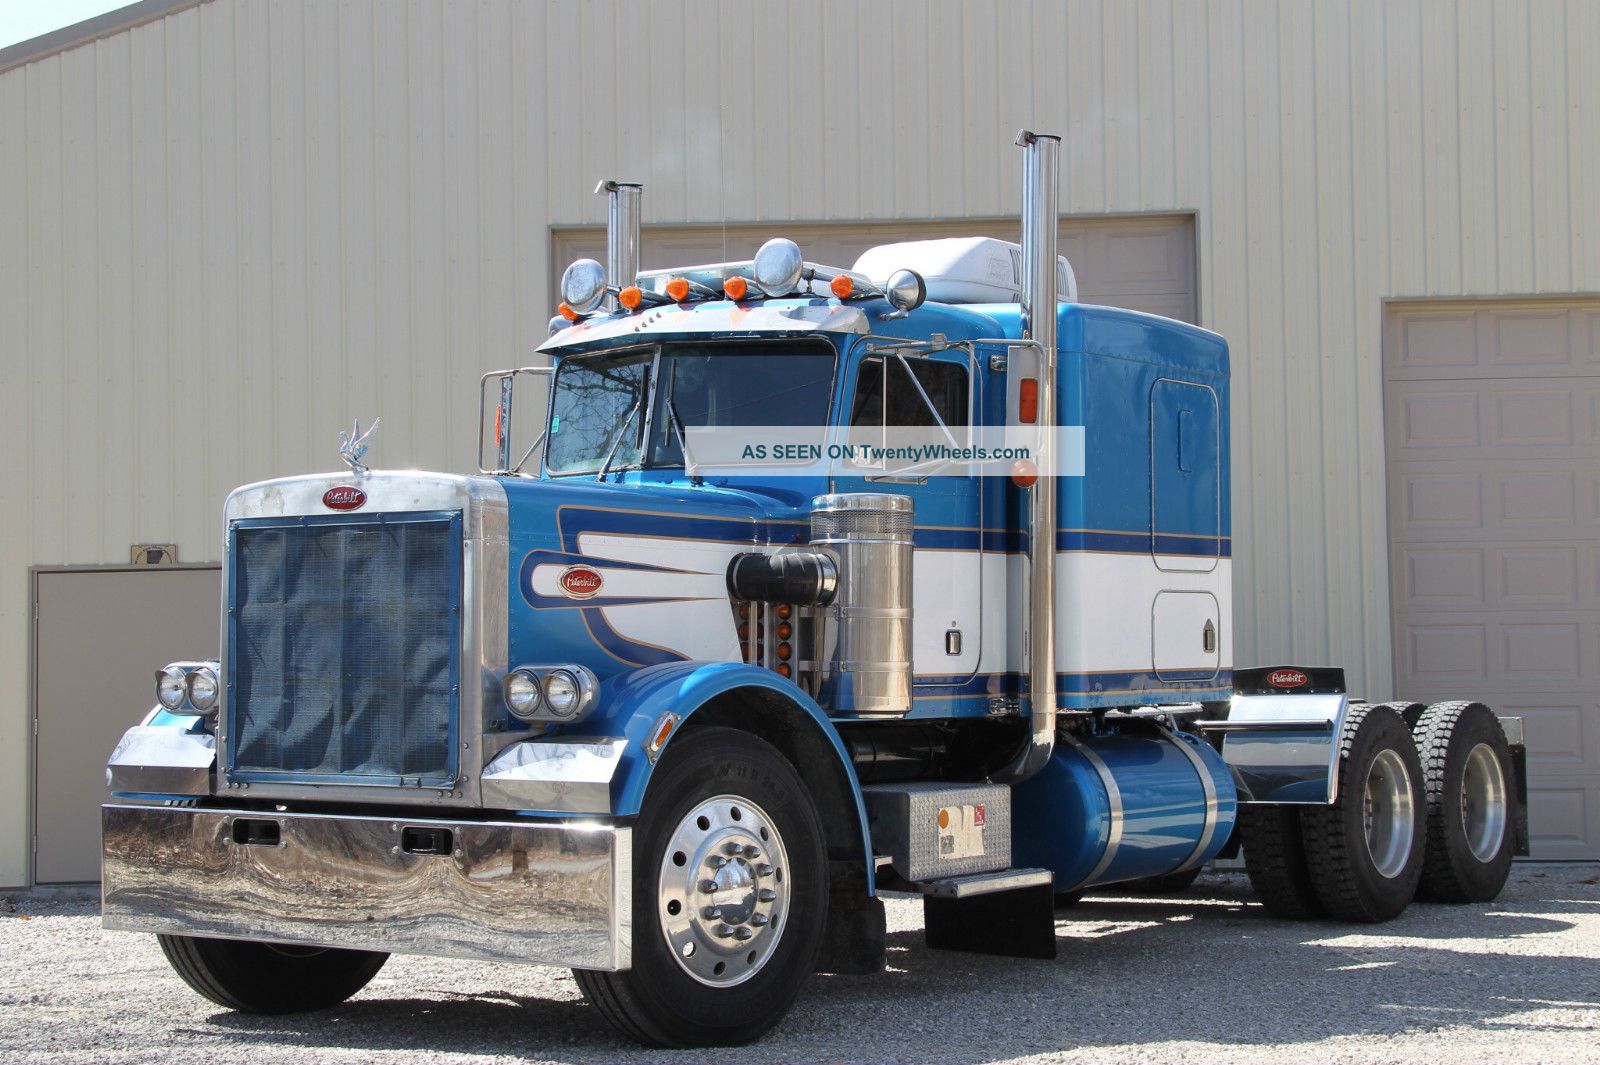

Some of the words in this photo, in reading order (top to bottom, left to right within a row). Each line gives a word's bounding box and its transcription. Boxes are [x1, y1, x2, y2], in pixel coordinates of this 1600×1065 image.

[326, 491, 362, 505] Peterbilt
[567, 574, 599, 588] Peterbilt
[1271, 672, 1305, 684] Peterbilt
